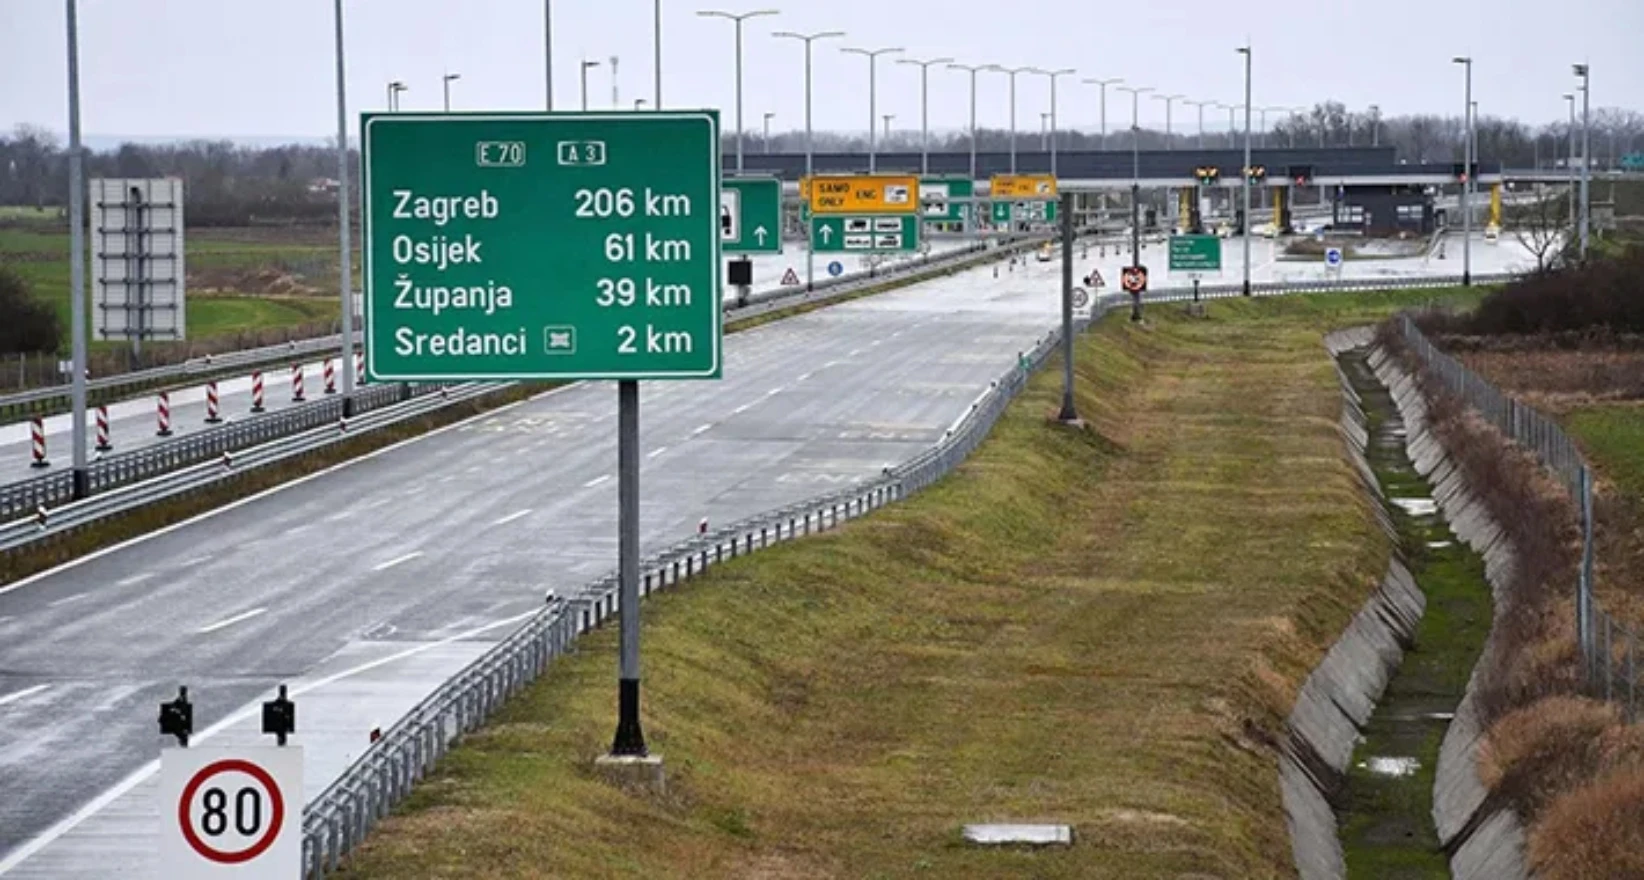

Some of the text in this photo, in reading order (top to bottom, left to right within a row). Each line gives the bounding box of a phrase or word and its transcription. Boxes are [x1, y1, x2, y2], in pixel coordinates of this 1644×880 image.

[481, 145, 522, 162] E 70
[569, 146, 595, 161] A 3
[393, 189, 690, 225] Zagreb 206 km
[393, 234, 690, 269] Osijek 61 km
[394, 275, 691, 314] Županja 39 km
[395, 325, 692, 355] Sredanci 2 km
[202, 786, 261, 837] 80
